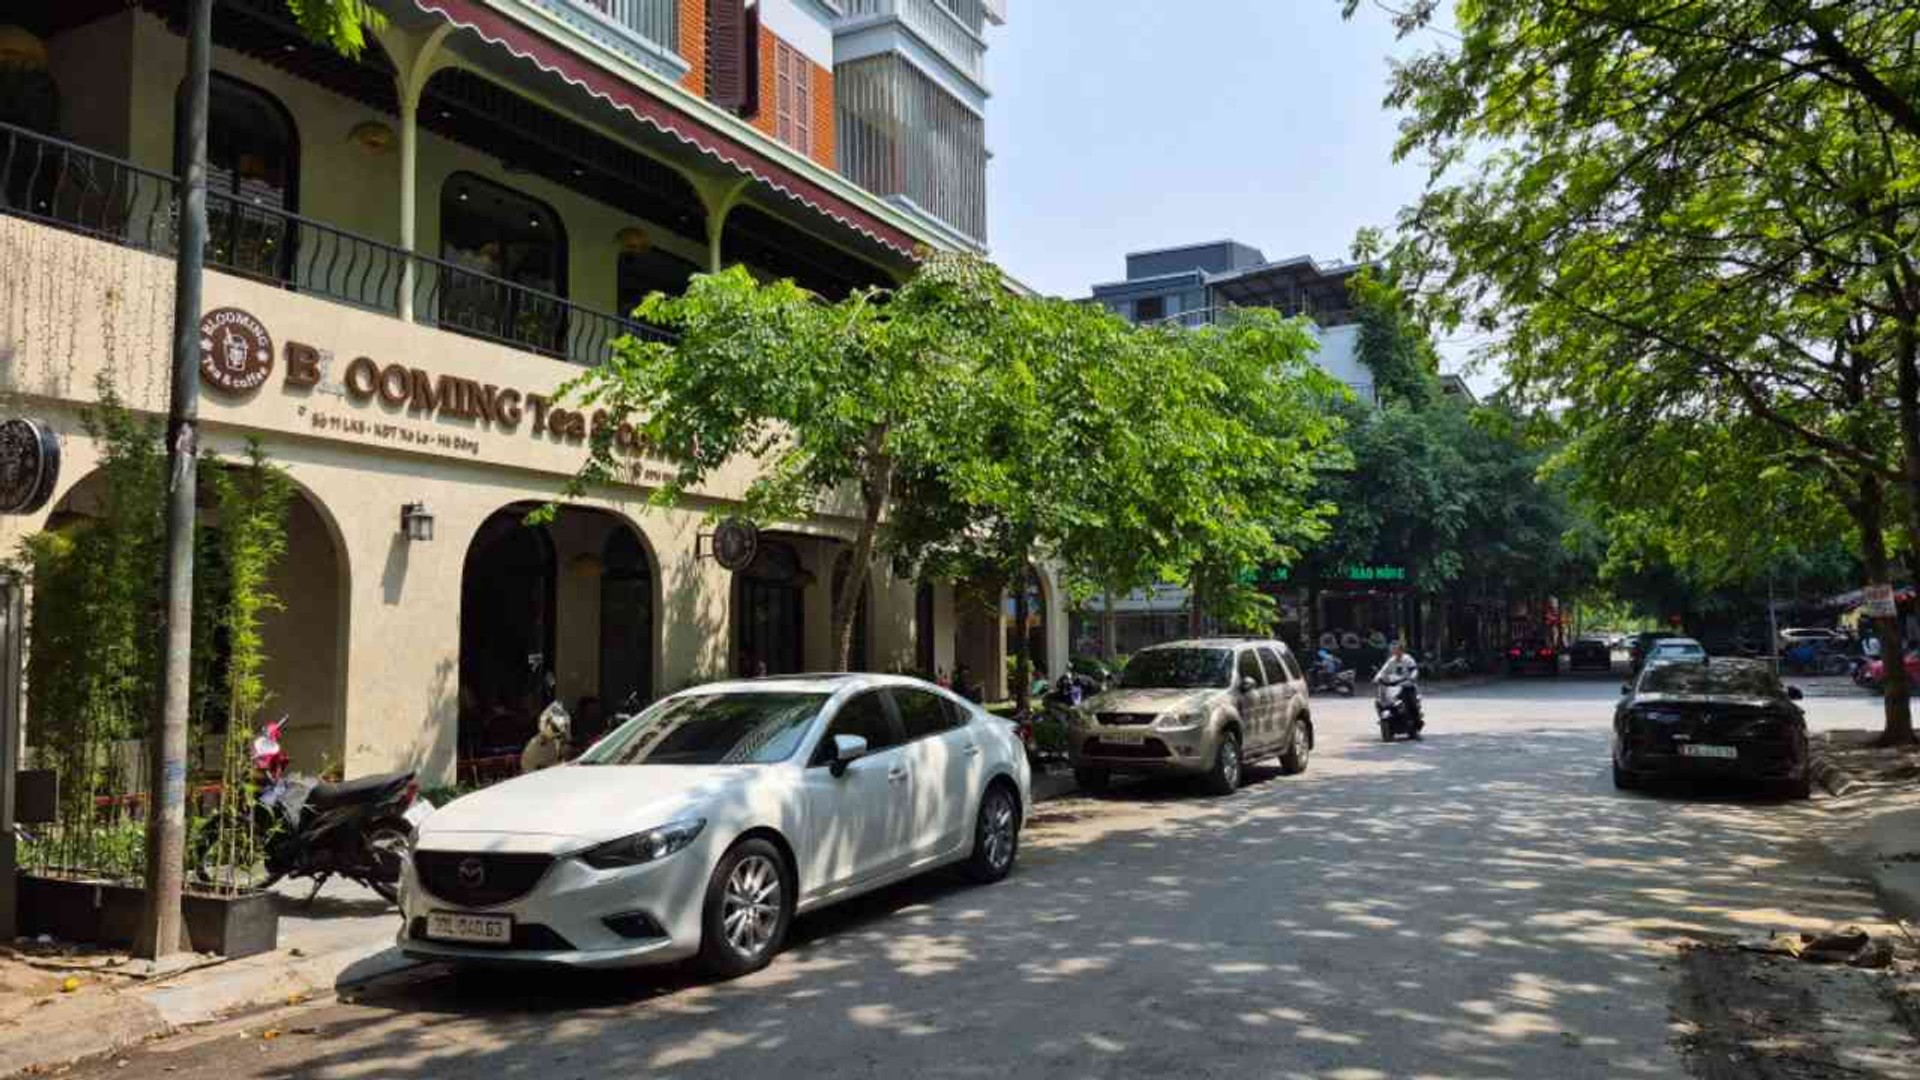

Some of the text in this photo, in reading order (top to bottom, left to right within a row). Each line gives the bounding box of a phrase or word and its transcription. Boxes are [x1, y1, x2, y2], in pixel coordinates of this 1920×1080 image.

[202, 311, 268, 347] BLOOMING
[284, 341, 522, 428] BLOOMING
[526, 393, 586, 439] Tea
